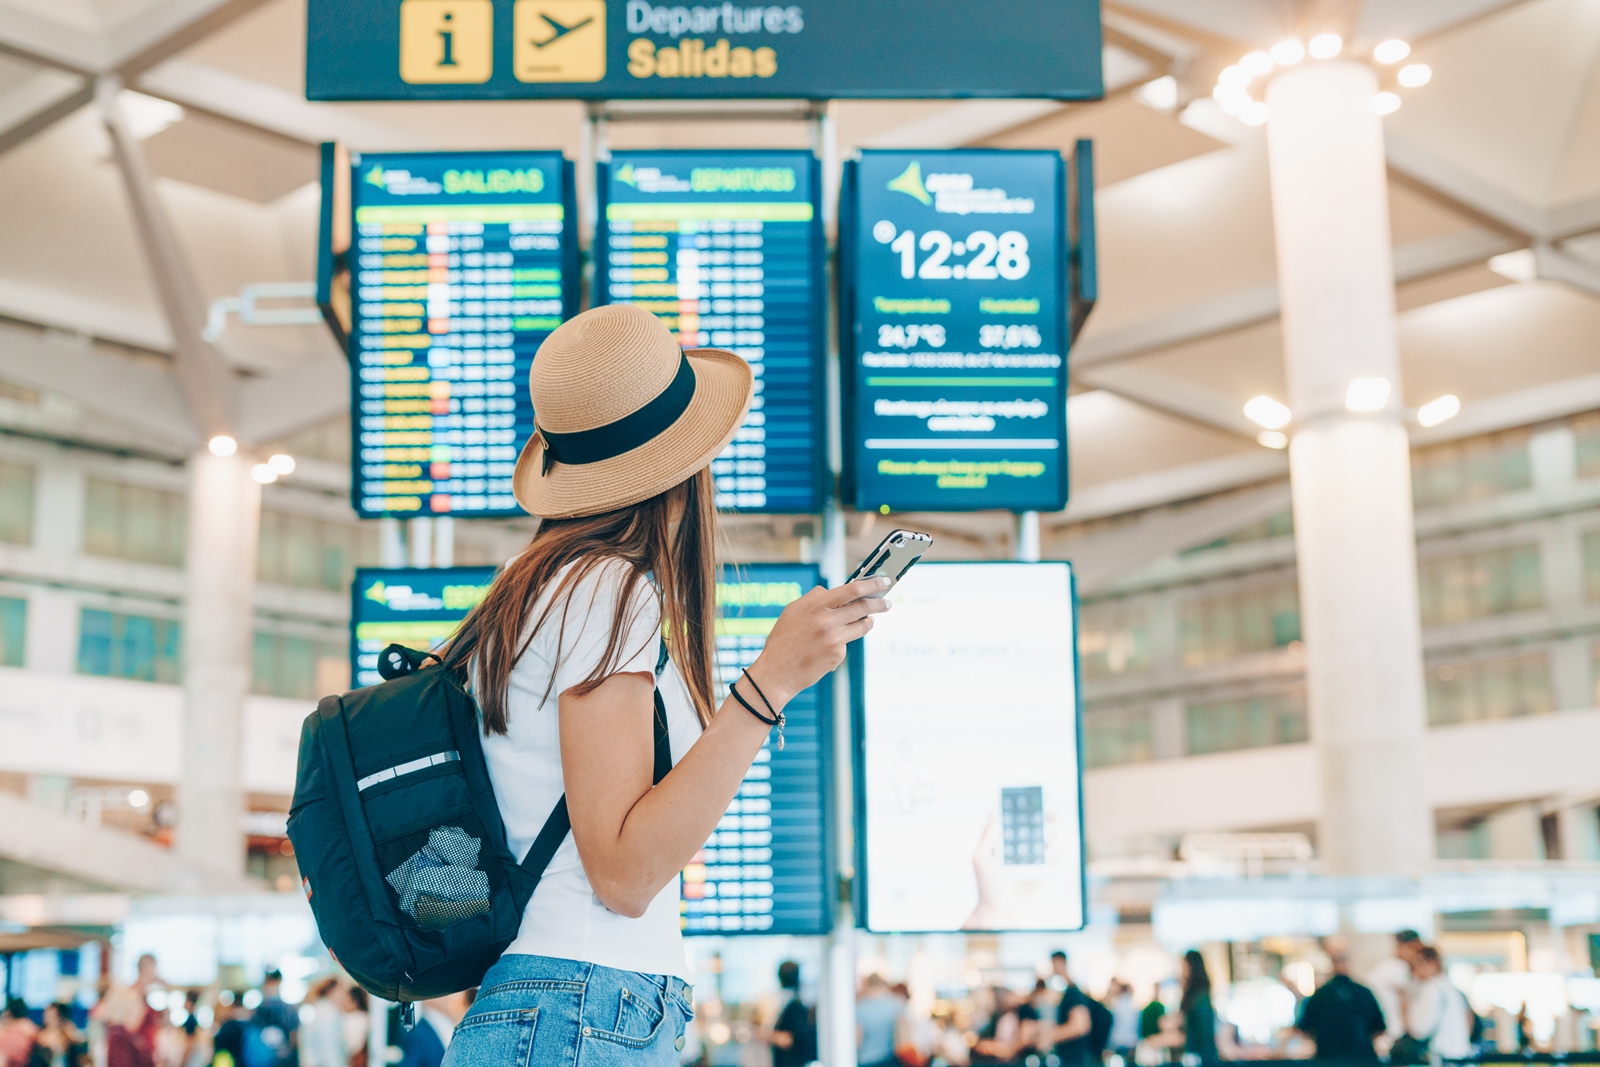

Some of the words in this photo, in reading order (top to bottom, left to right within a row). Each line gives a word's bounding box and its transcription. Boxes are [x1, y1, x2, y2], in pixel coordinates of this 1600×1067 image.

[627, 0, 804, 38] Departures
[627, 38, 778, 78] Salidas
[443, 168, 544, 194] SALIDAS
[691, 168, 796, 192] DEPARTURES
[890, 229, 1031, 281] 12:28
